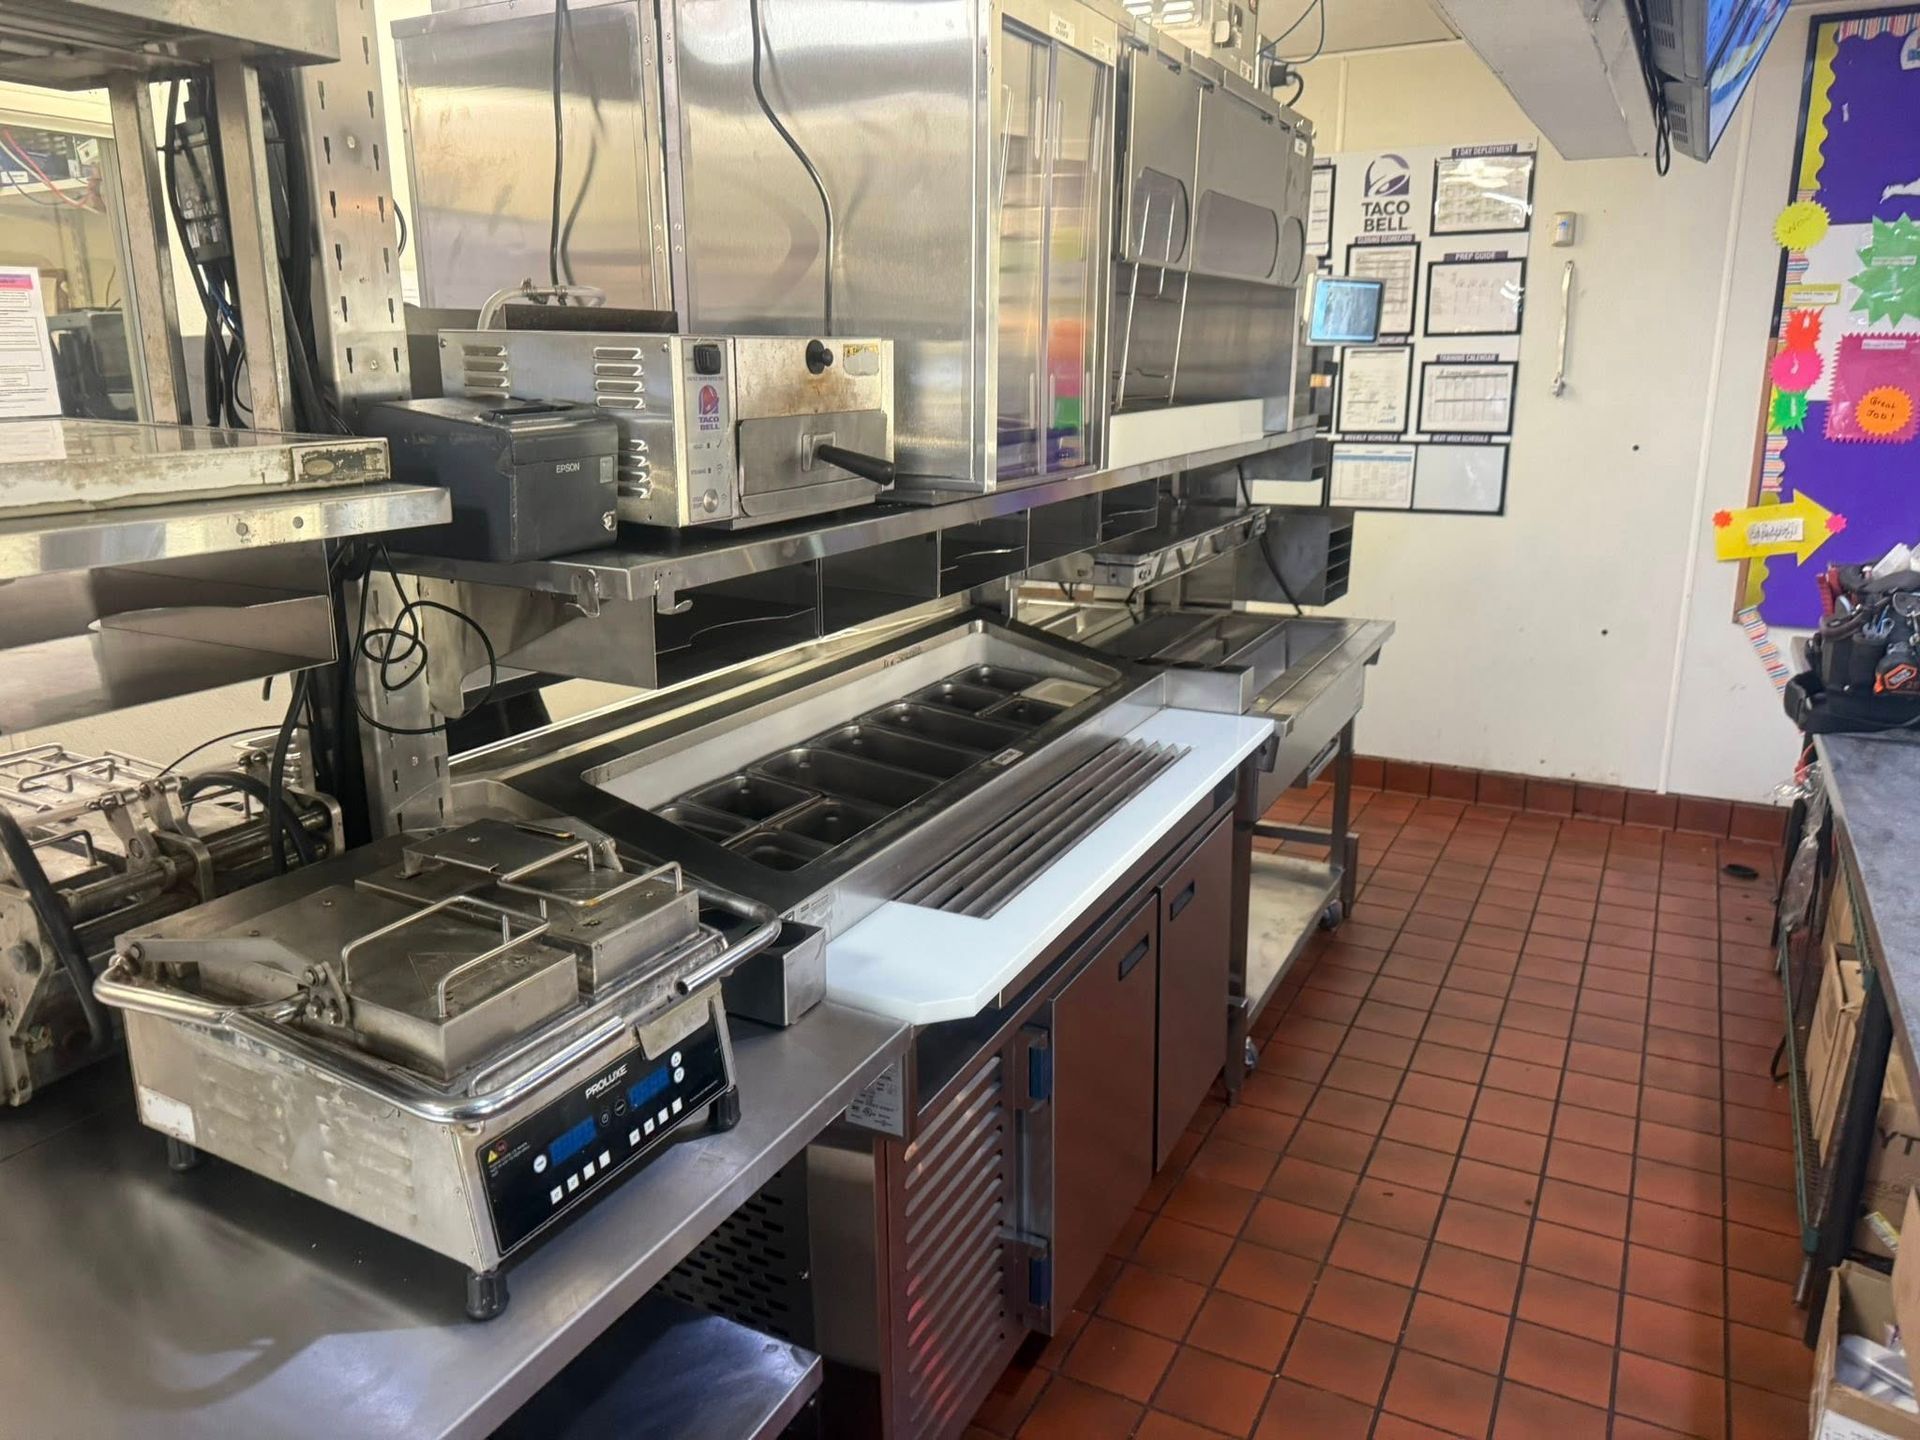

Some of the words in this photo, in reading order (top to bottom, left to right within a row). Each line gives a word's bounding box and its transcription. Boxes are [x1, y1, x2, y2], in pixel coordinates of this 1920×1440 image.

[1460, 147, 1473, 157] DAY
[1473, 144, 1514, 156] DEPLOYMENT
[1361, 200, 1410, 217] TACO
[1363, 217, 1408, 233] BELL
[1455, 252, 1473, 261] PREP
[1474, 251, 1496, 260] GUIDE
[1869, 396, 1896, 410] Great
[698, 416, 720, 424] TACO
[699, 423, 720, 431] BELL
[556, 462, 580, 474] EPSON
[584, 1063, 629, 1099] PROLUXE
